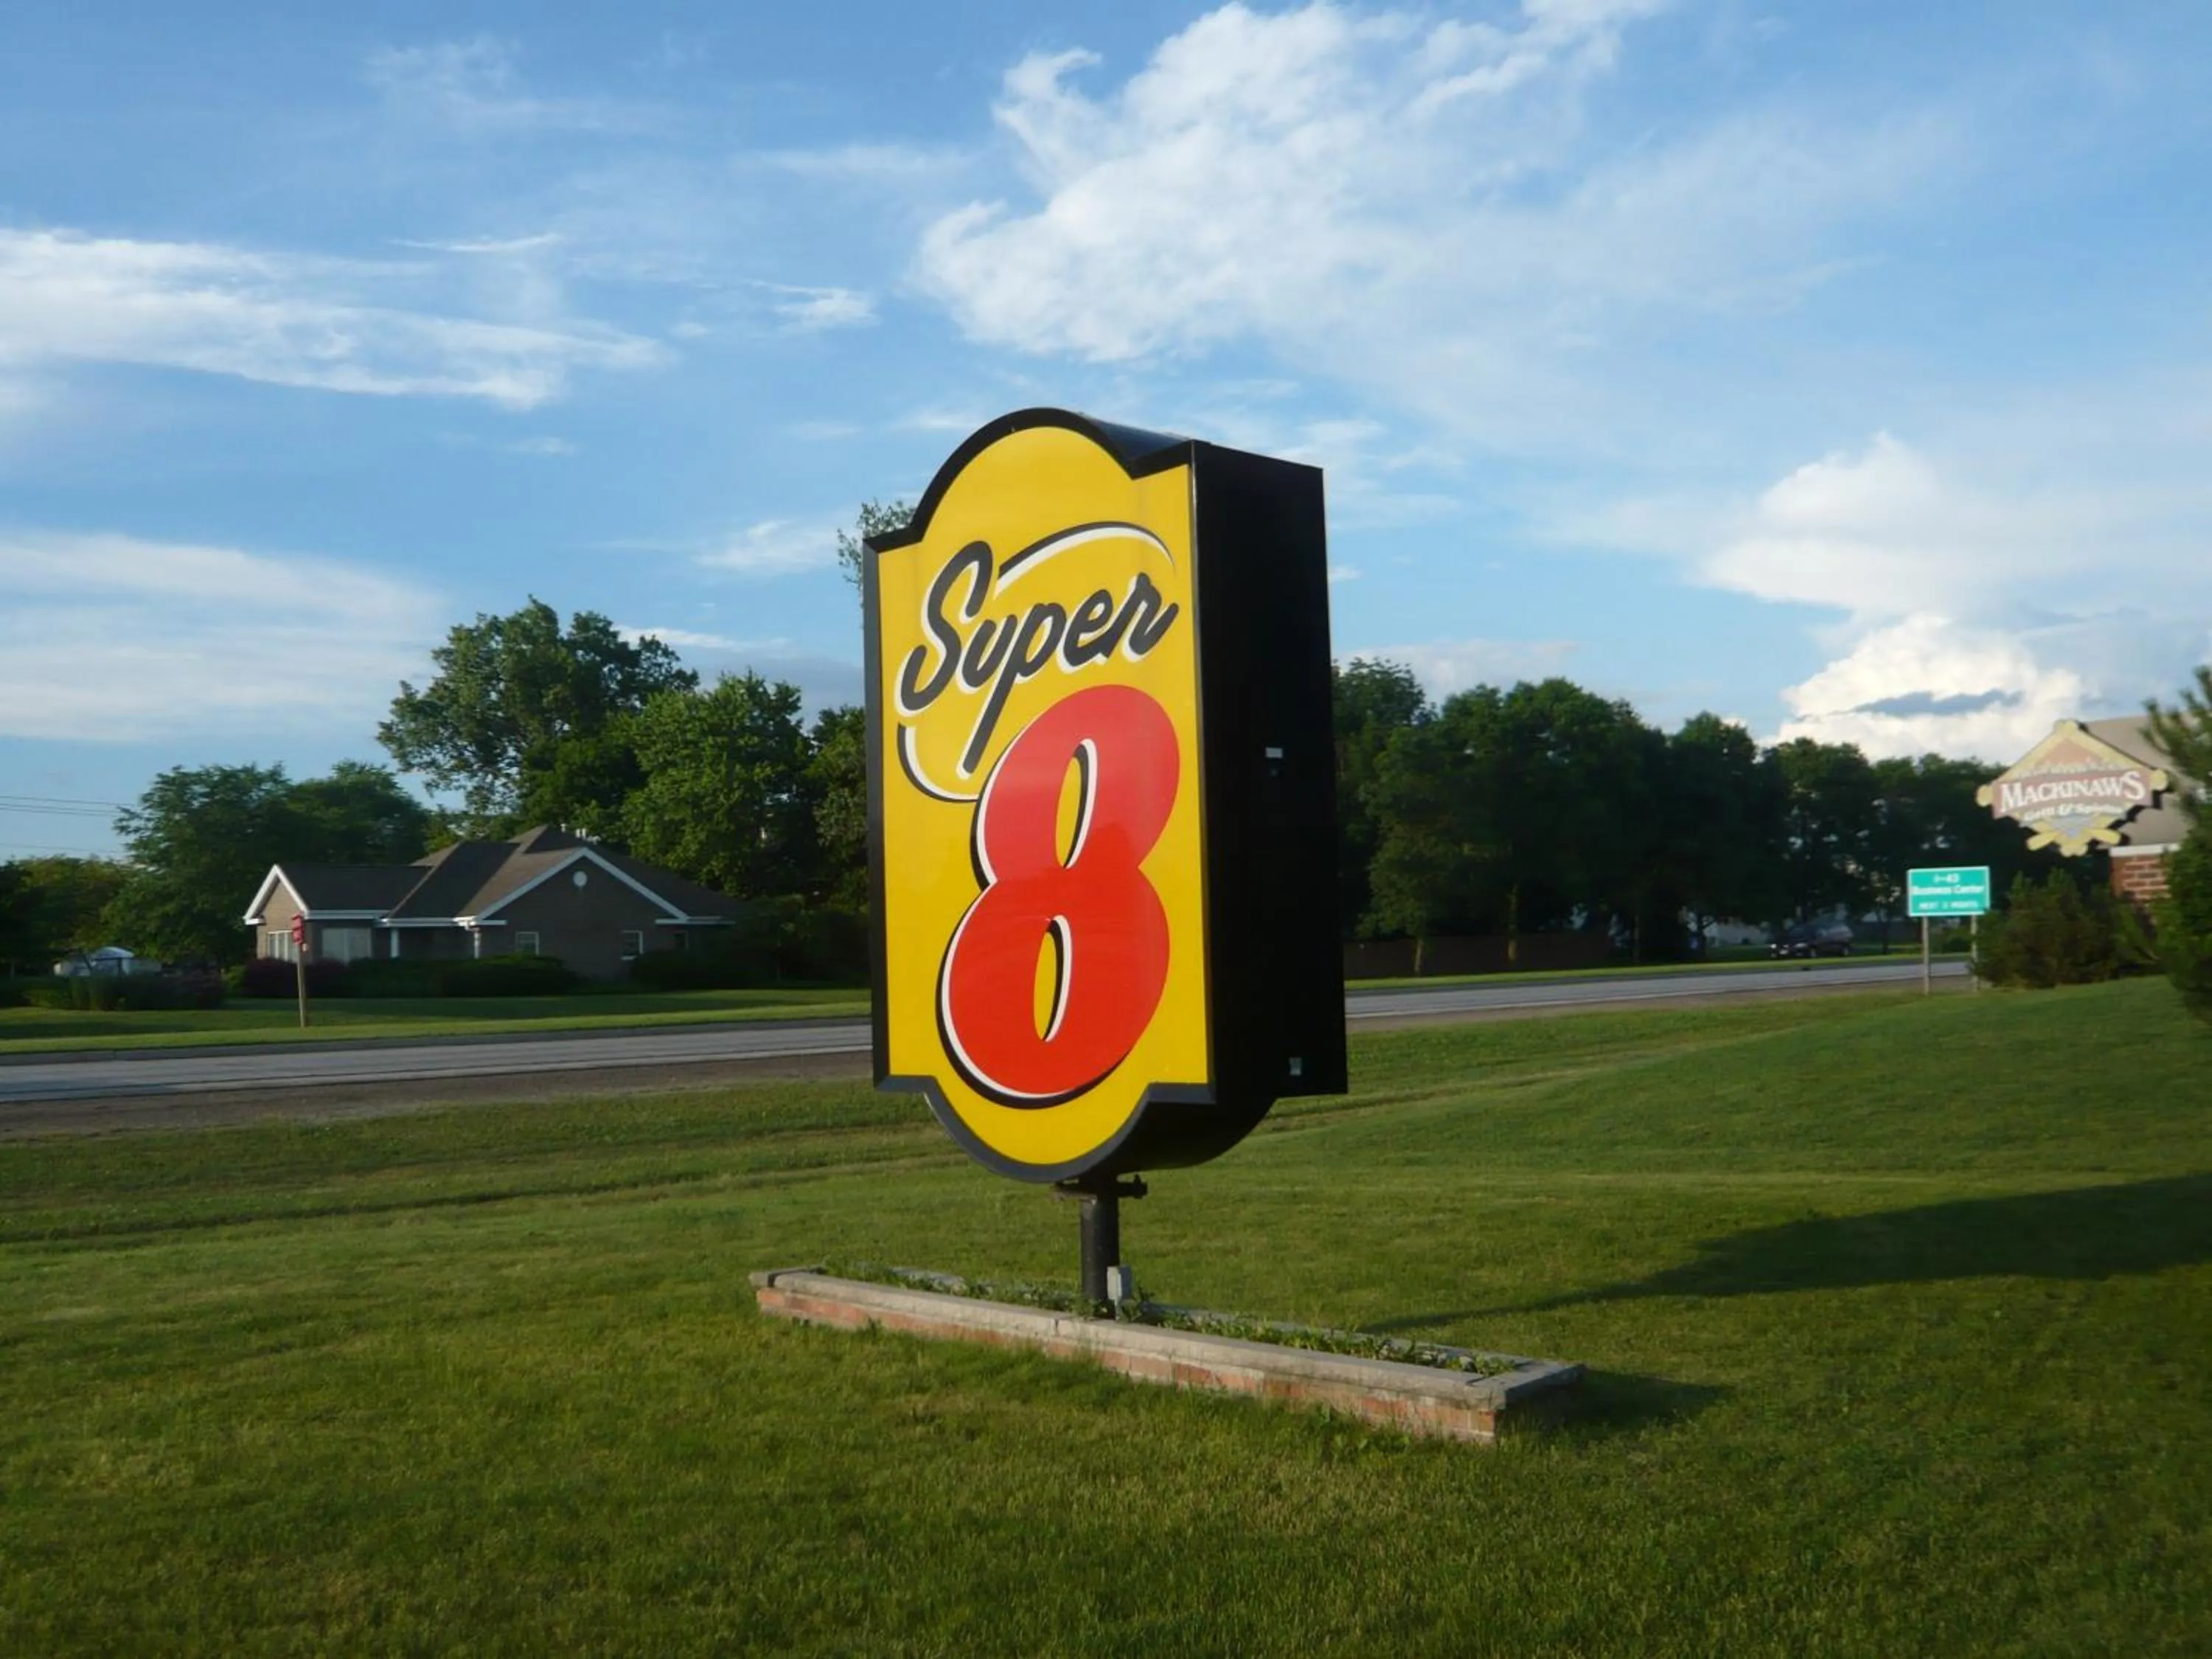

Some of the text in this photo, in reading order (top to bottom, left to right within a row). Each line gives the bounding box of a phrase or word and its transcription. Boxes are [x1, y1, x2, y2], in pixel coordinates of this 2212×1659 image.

[896, 540, 1180, 779] Super
[935, 684, 1180, 1108] 8
[2000, 771, 2146, 814] MACKINAWS
